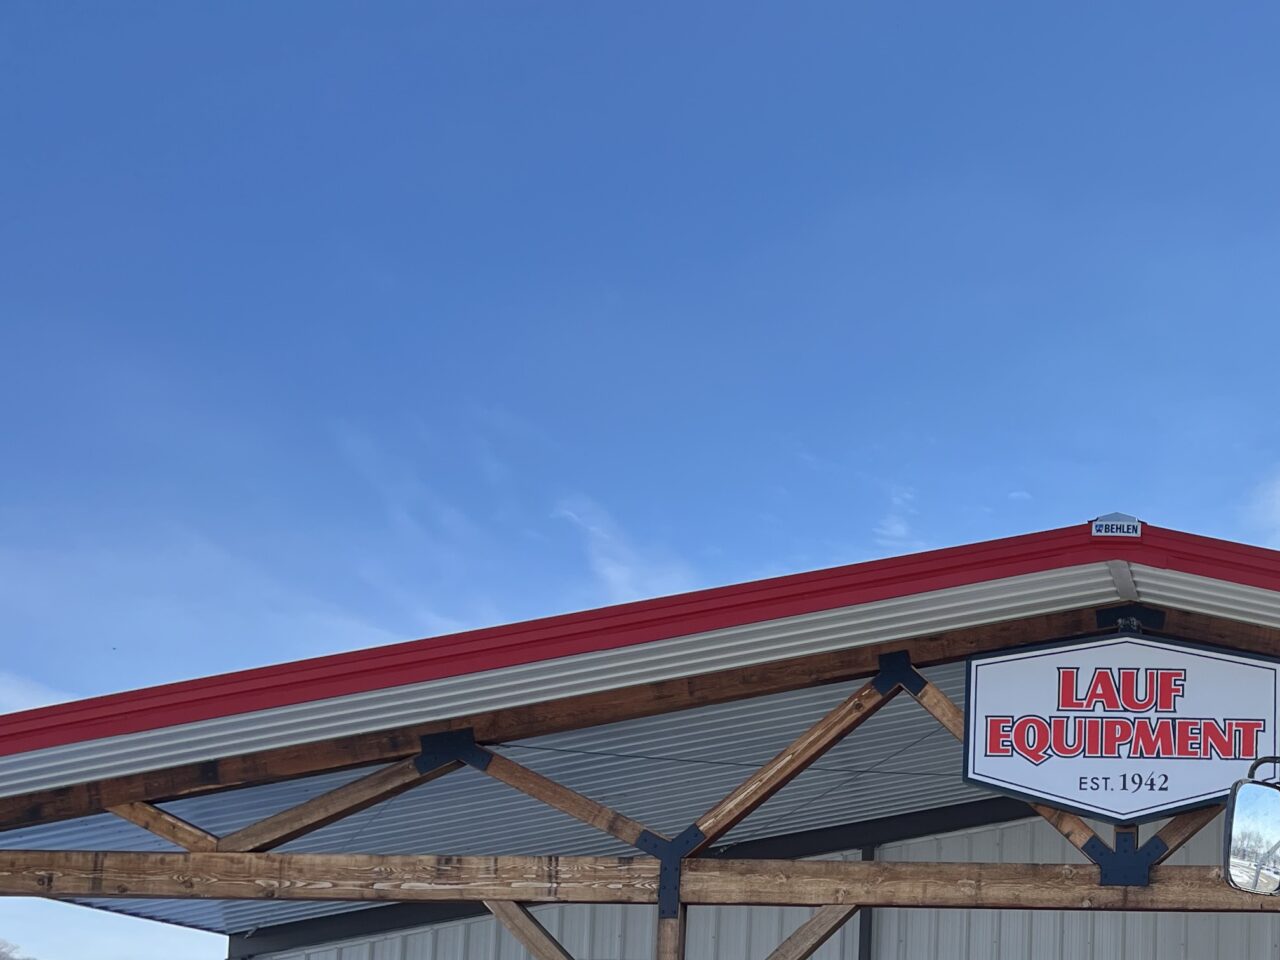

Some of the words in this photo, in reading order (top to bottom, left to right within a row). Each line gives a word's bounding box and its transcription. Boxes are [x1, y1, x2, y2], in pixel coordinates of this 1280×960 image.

[1104, 523, 1138, 535] BEHLEN
[1057, 667, 1187, 713] LAUF
[984, 715, 1266, 766] EQUIPMENT
[1078, 775, 1115, 792] EST.
[1118, 773, 1169, 792] 1942
